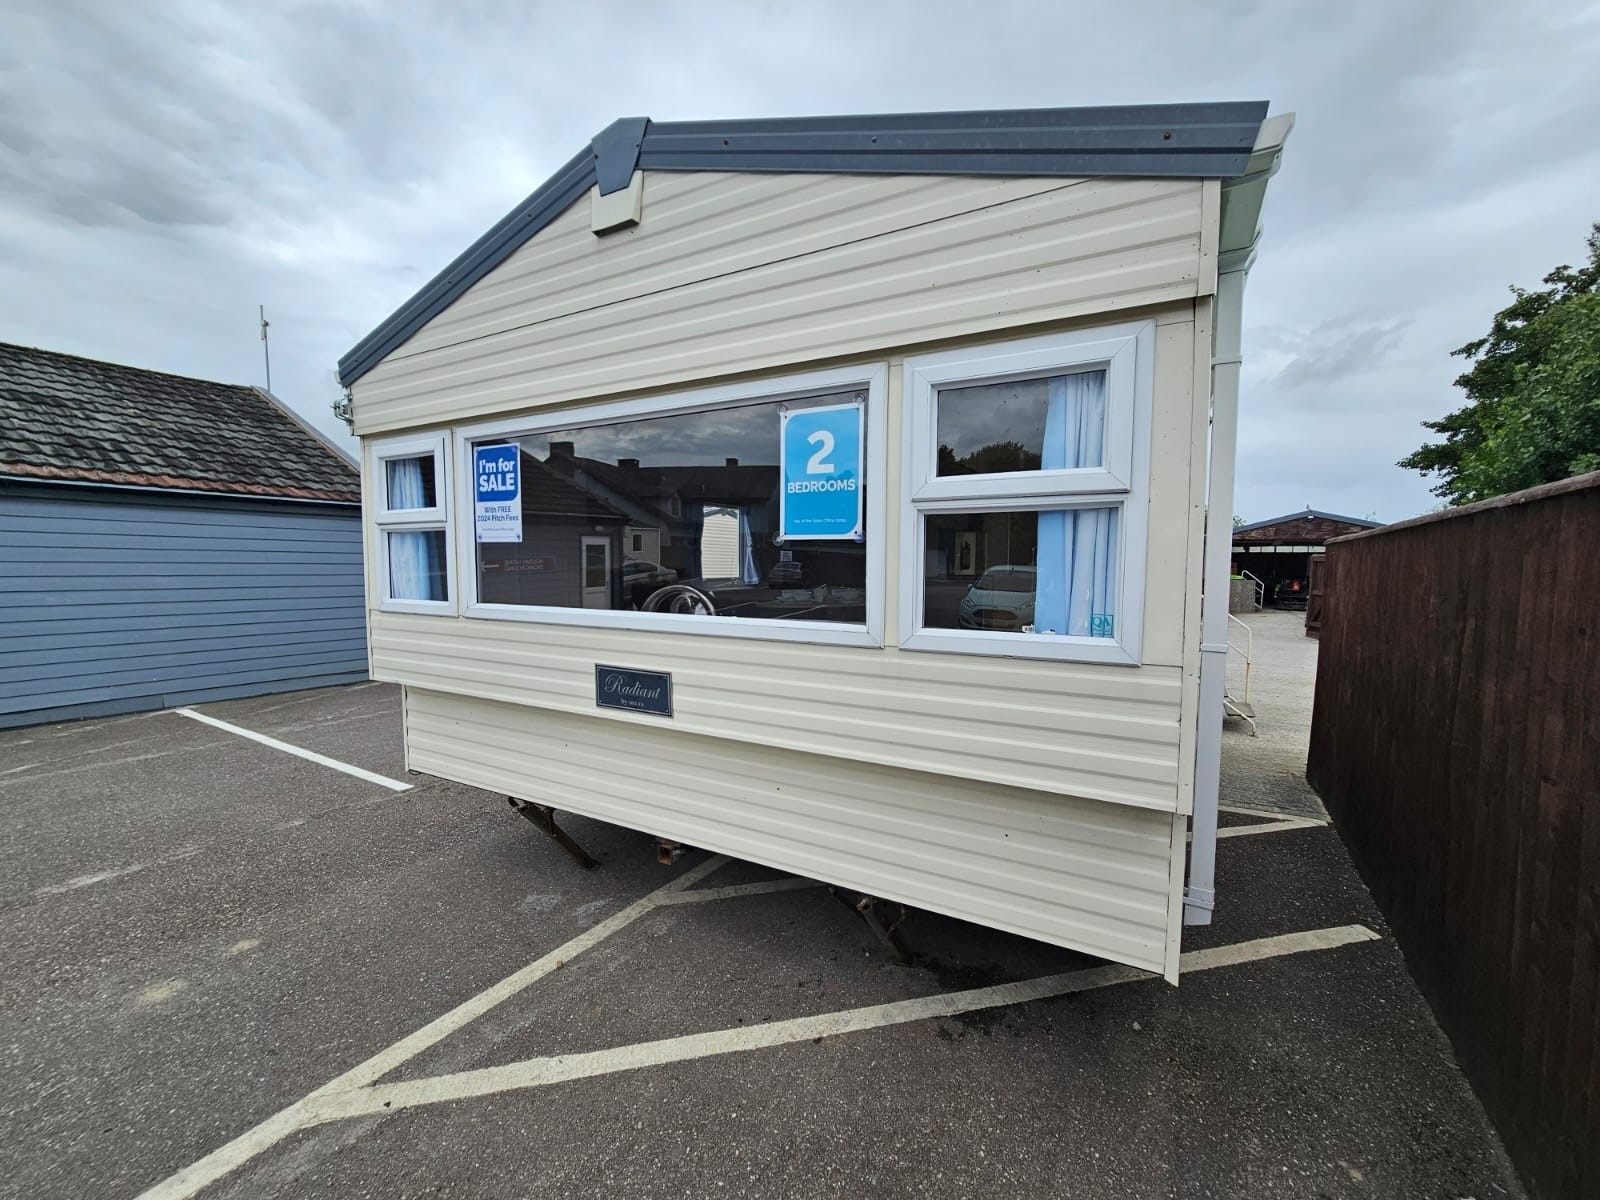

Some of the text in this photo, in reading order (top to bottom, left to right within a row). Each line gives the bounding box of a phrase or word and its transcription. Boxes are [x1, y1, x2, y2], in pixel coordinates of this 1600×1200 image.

[806, 429, 835, 475] 2
[479, 457, 516, 474] I'm for
[479, 472, 516, 493] SALE
[787, 479, 856, 494] BEDROOMS
[477, 513, 520, 522] 2024 Pitch Fees
[483, 505, 512, 513] With FREE
[604, 673, 661, 699] Radiant
